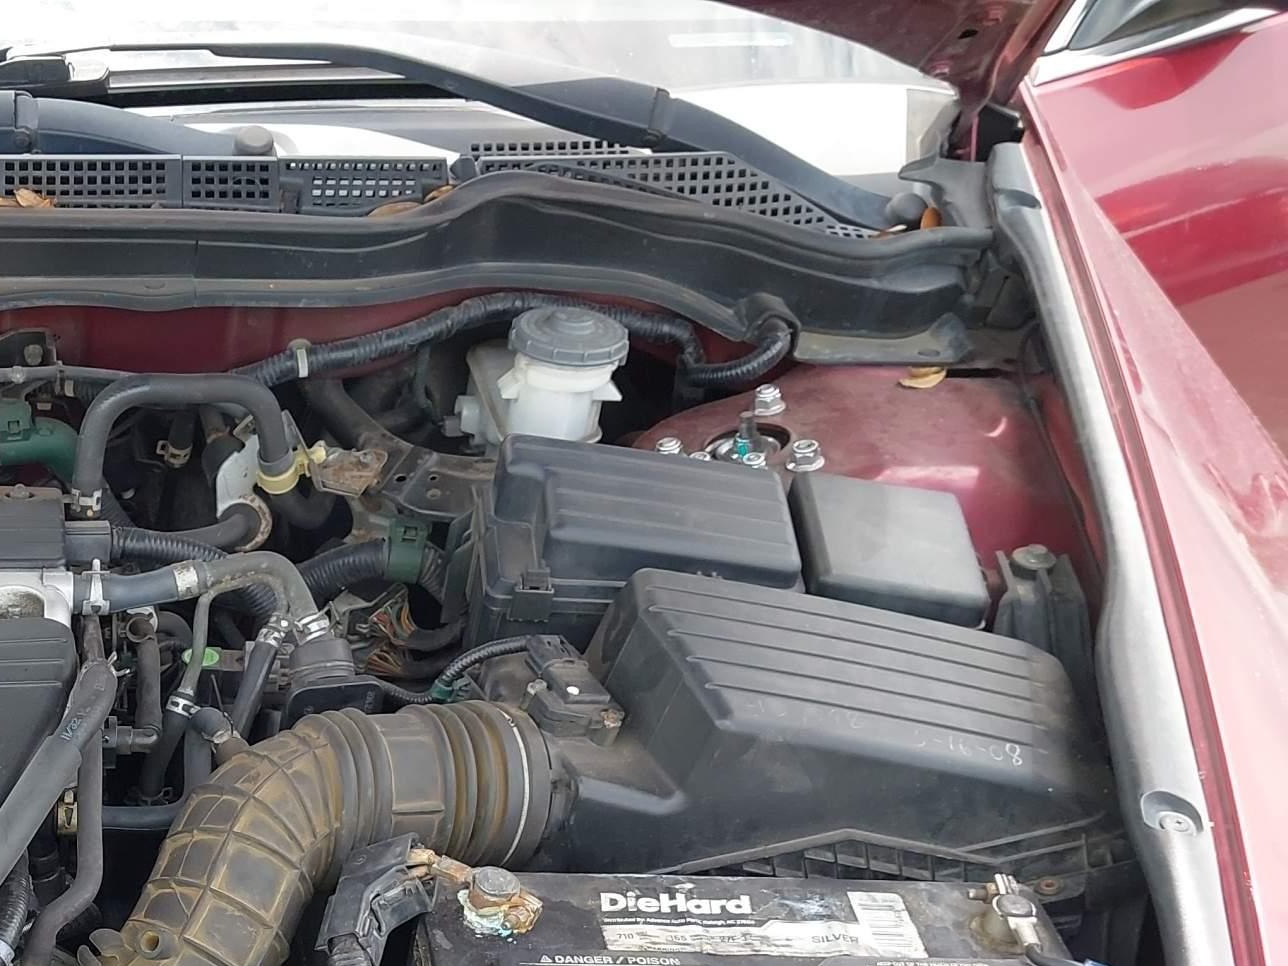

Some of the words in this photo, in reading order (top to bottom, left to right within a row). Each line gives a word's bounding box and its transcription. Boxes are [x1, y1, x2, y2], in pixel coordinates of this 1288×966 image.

[599, 891, 753, 915] DieHard
[811, 933, 859, 944] SILVER
[554, 956, 612, 965] DANGER
[616, 956, 622, 965] /
[627, 957, 680, 965] POISON
